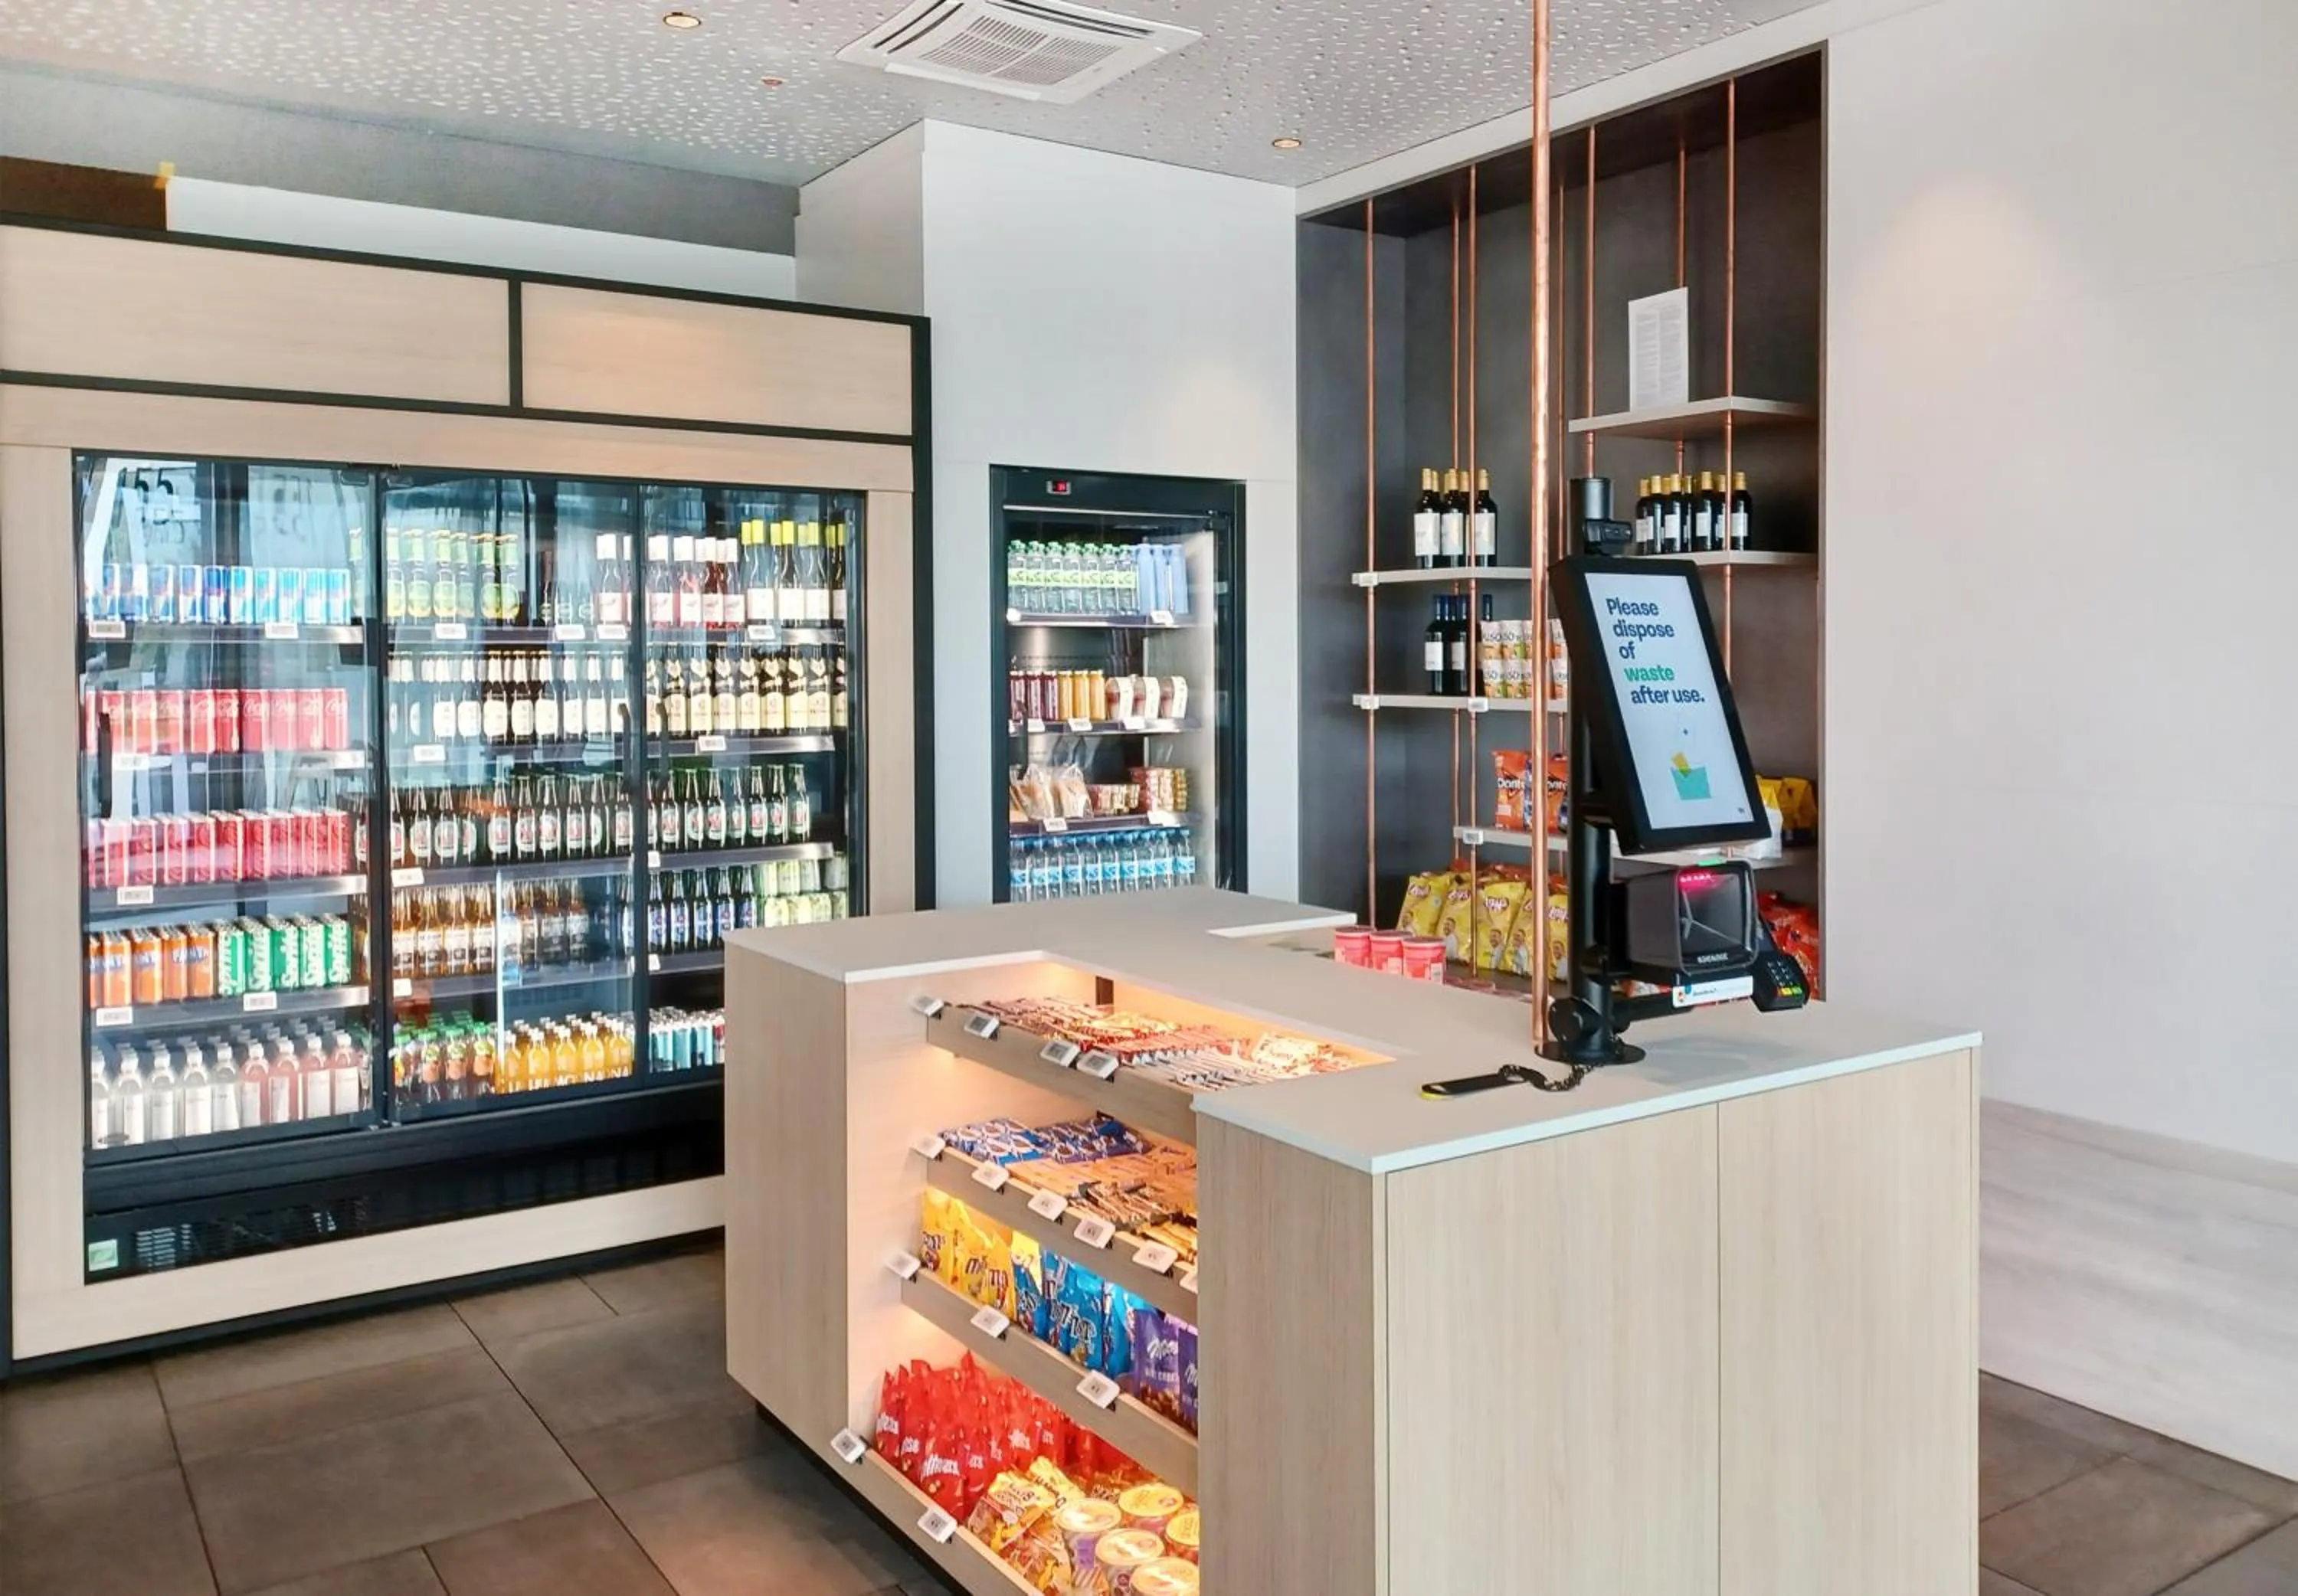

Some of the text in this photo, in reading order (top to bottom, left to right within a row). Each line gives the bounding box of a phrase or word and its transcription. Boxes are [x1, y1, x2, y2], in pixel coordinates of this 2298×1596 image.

[1606, 597, 1660, 616] Please
[1612, 620, 1675, 642] dispose
[1618, 641, 1636, 659] of
[1623, 665, 1675, 682] waste
[1631, 685, 1706, 705] after use.
